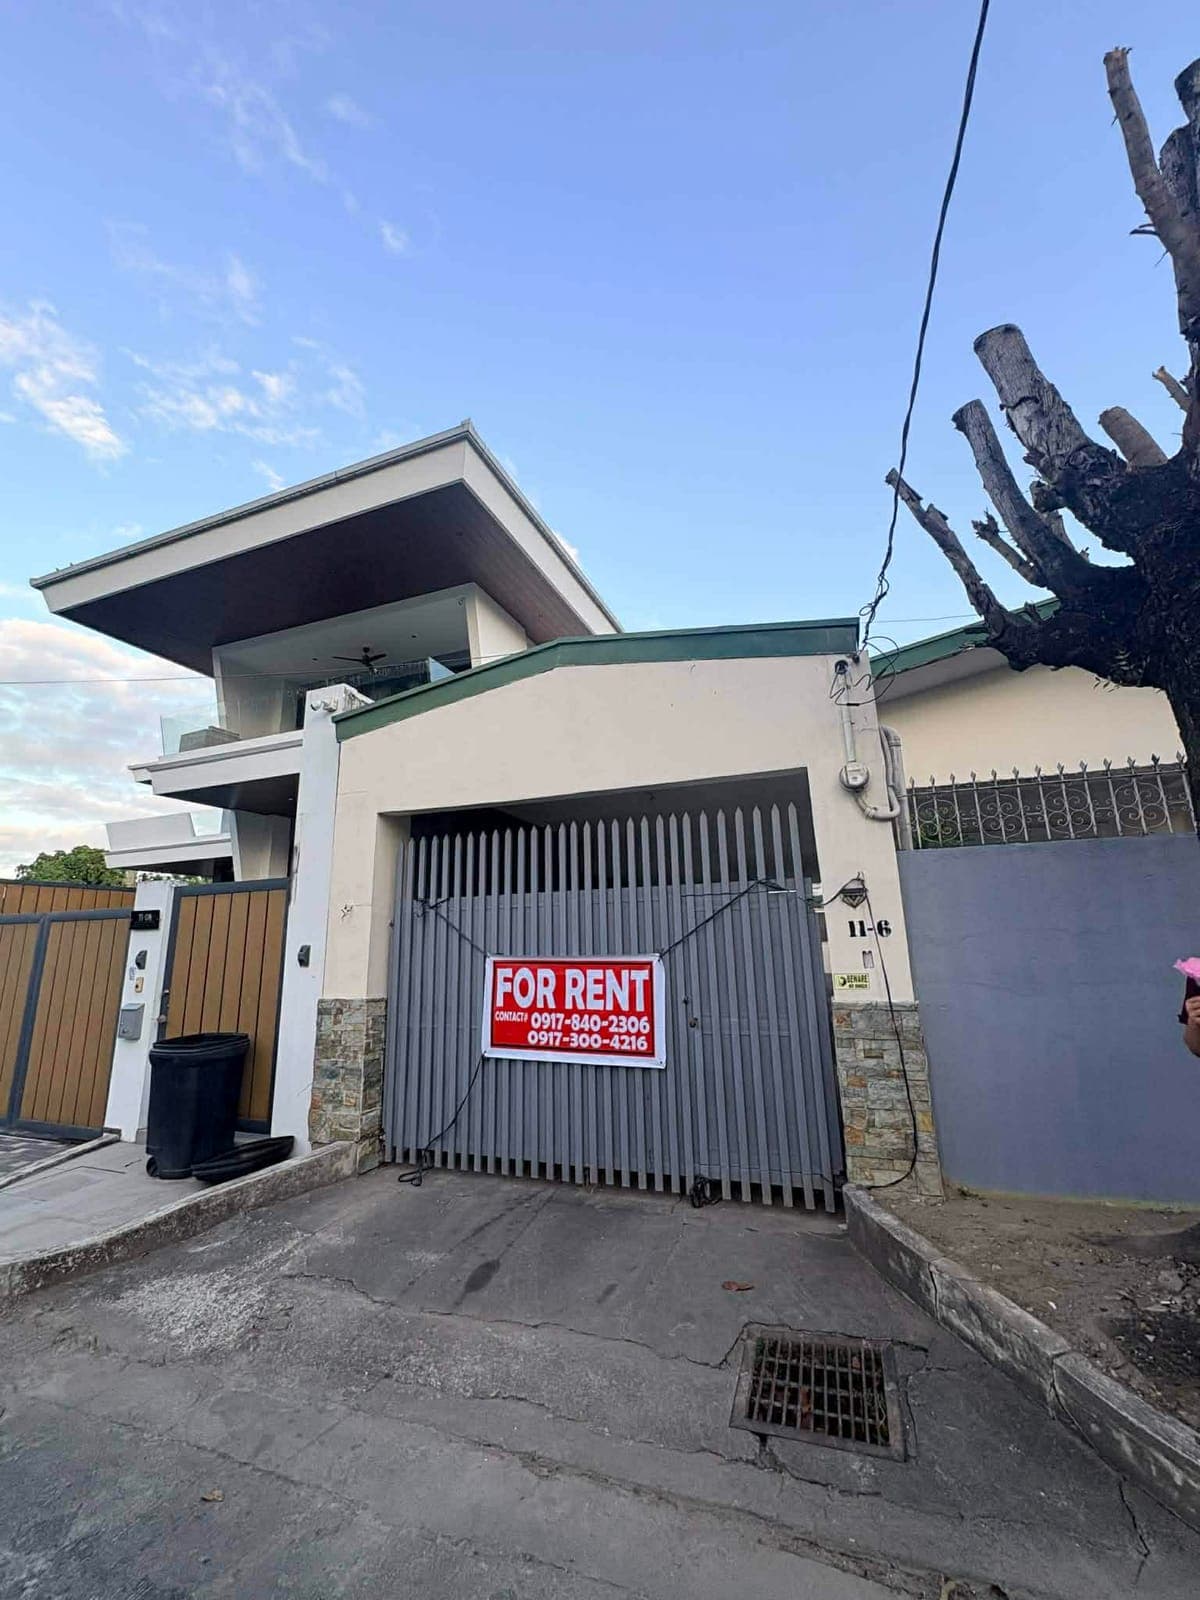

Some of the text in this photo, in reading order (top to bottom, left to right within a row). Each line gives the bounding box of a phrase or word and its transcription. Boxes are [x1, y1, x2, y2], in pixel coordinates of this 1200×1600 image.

[848, 920, 892, 937] 11-6
[496, 967, 649, 1012] FOR RENT
[531, 1012, 650, 1033] 0917-840-2306
[527, 1031, 648, 1050] 0917-300-4216
